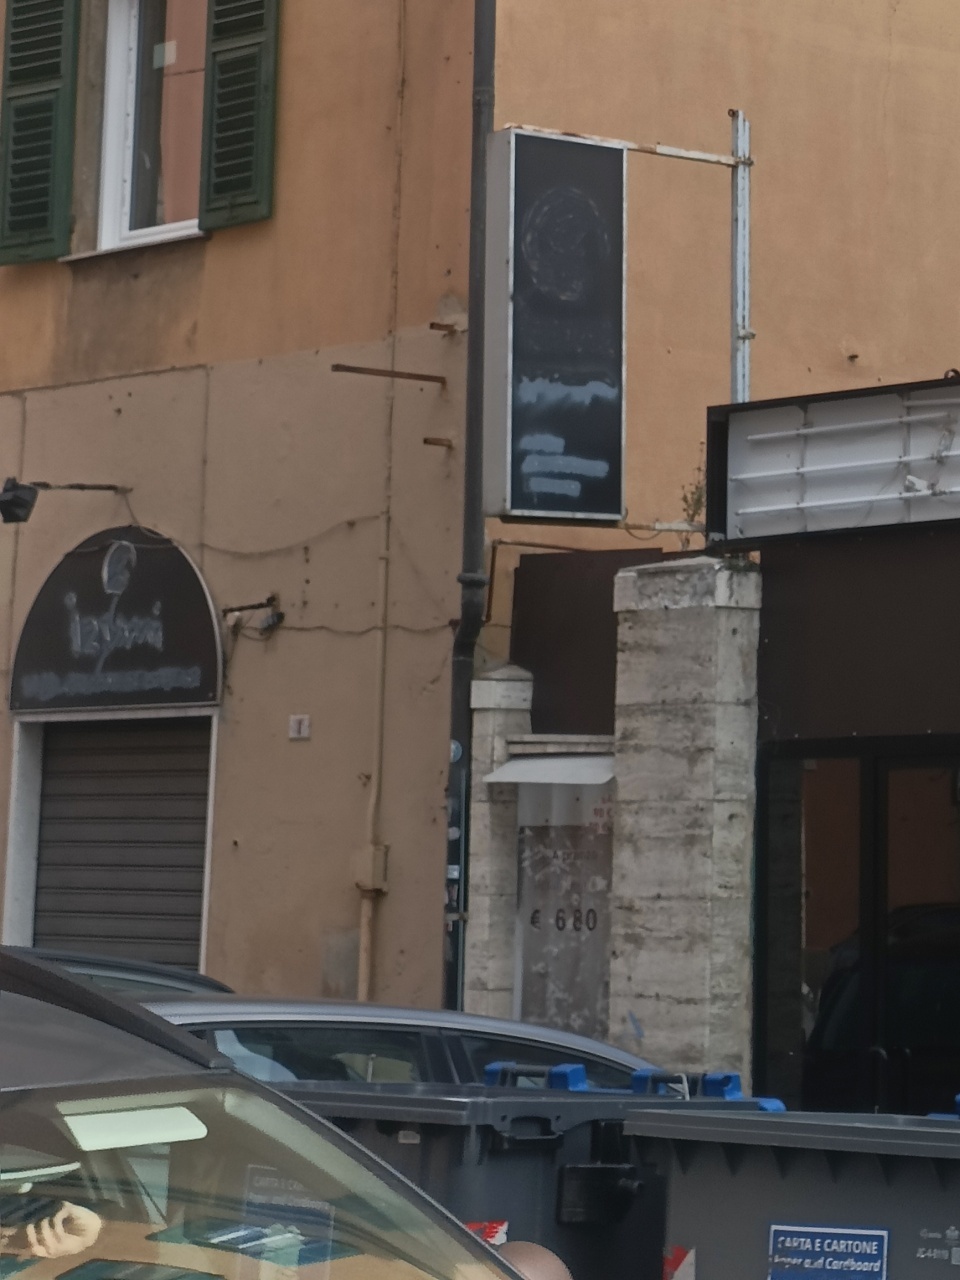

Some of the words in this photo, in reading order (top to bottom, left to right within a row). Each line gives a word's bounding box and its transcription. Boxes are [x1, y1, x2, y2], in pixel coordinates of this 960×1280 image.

[814, 1238, 822, 1251] E
[823, 1239, 878, 1254] CARTONE
[825, 1257, 881, 1272] Cardboard
